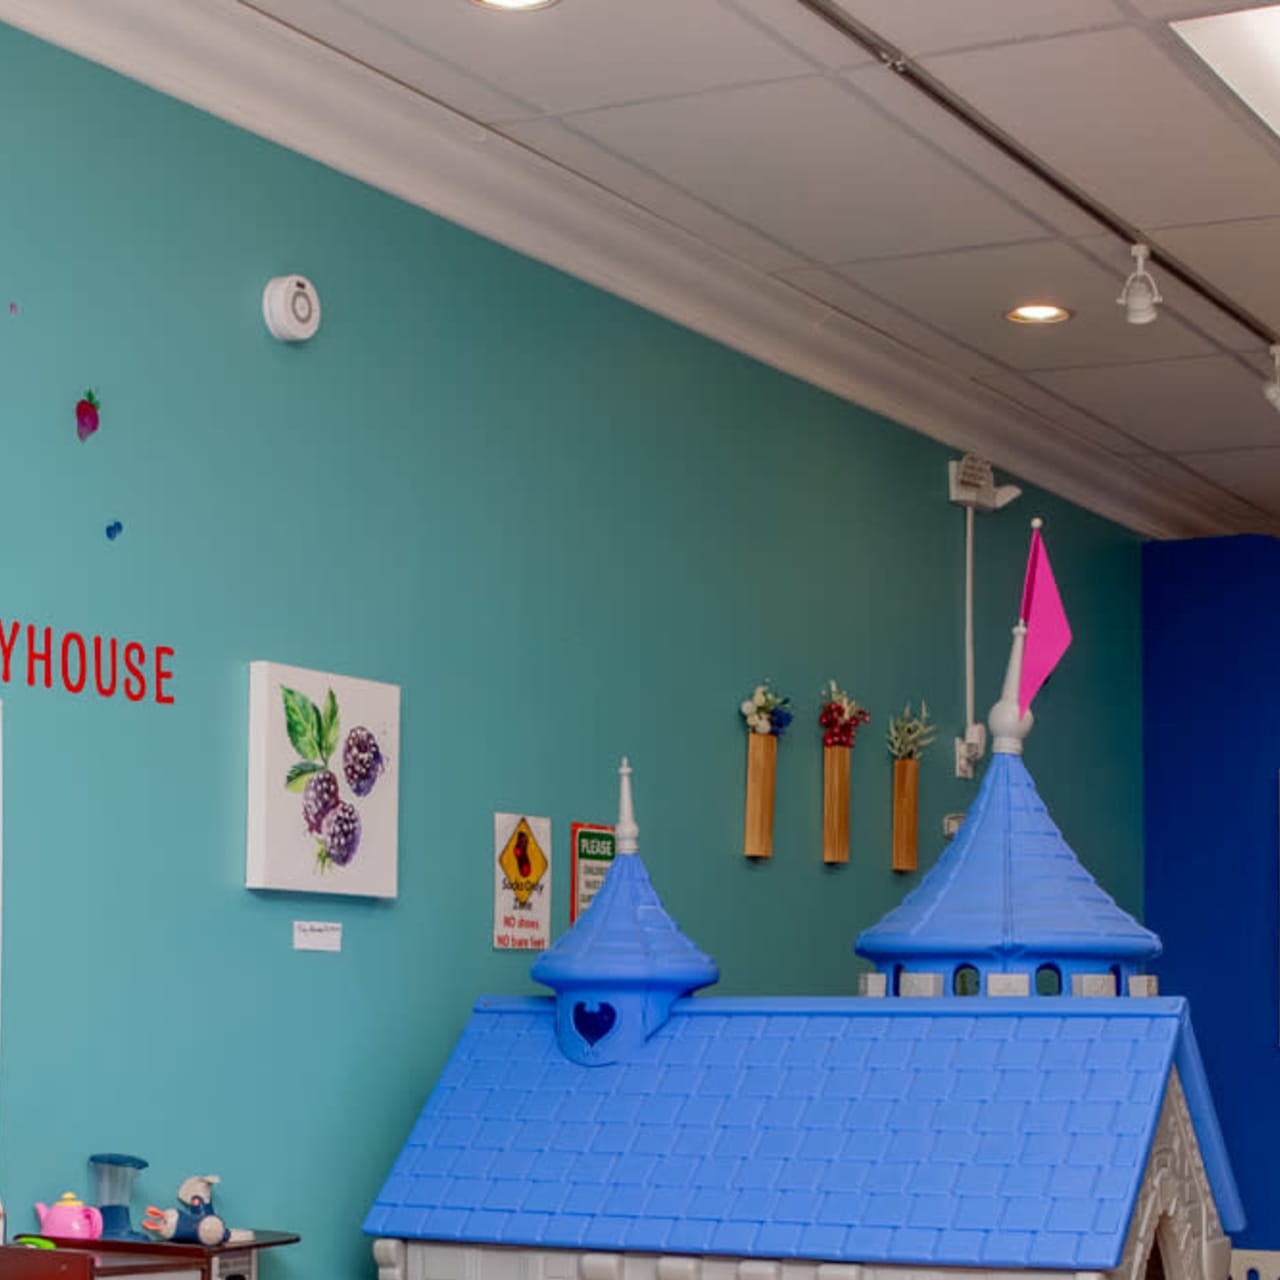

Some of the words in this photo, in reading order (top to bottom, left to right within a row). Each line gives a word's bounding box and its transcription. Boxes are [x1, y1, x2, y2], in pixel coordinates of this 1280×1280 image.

[580, 838, 613, 856] PLEASE
[503, 916, 516, 929] NO
[496, 934, 510, 948] NO
